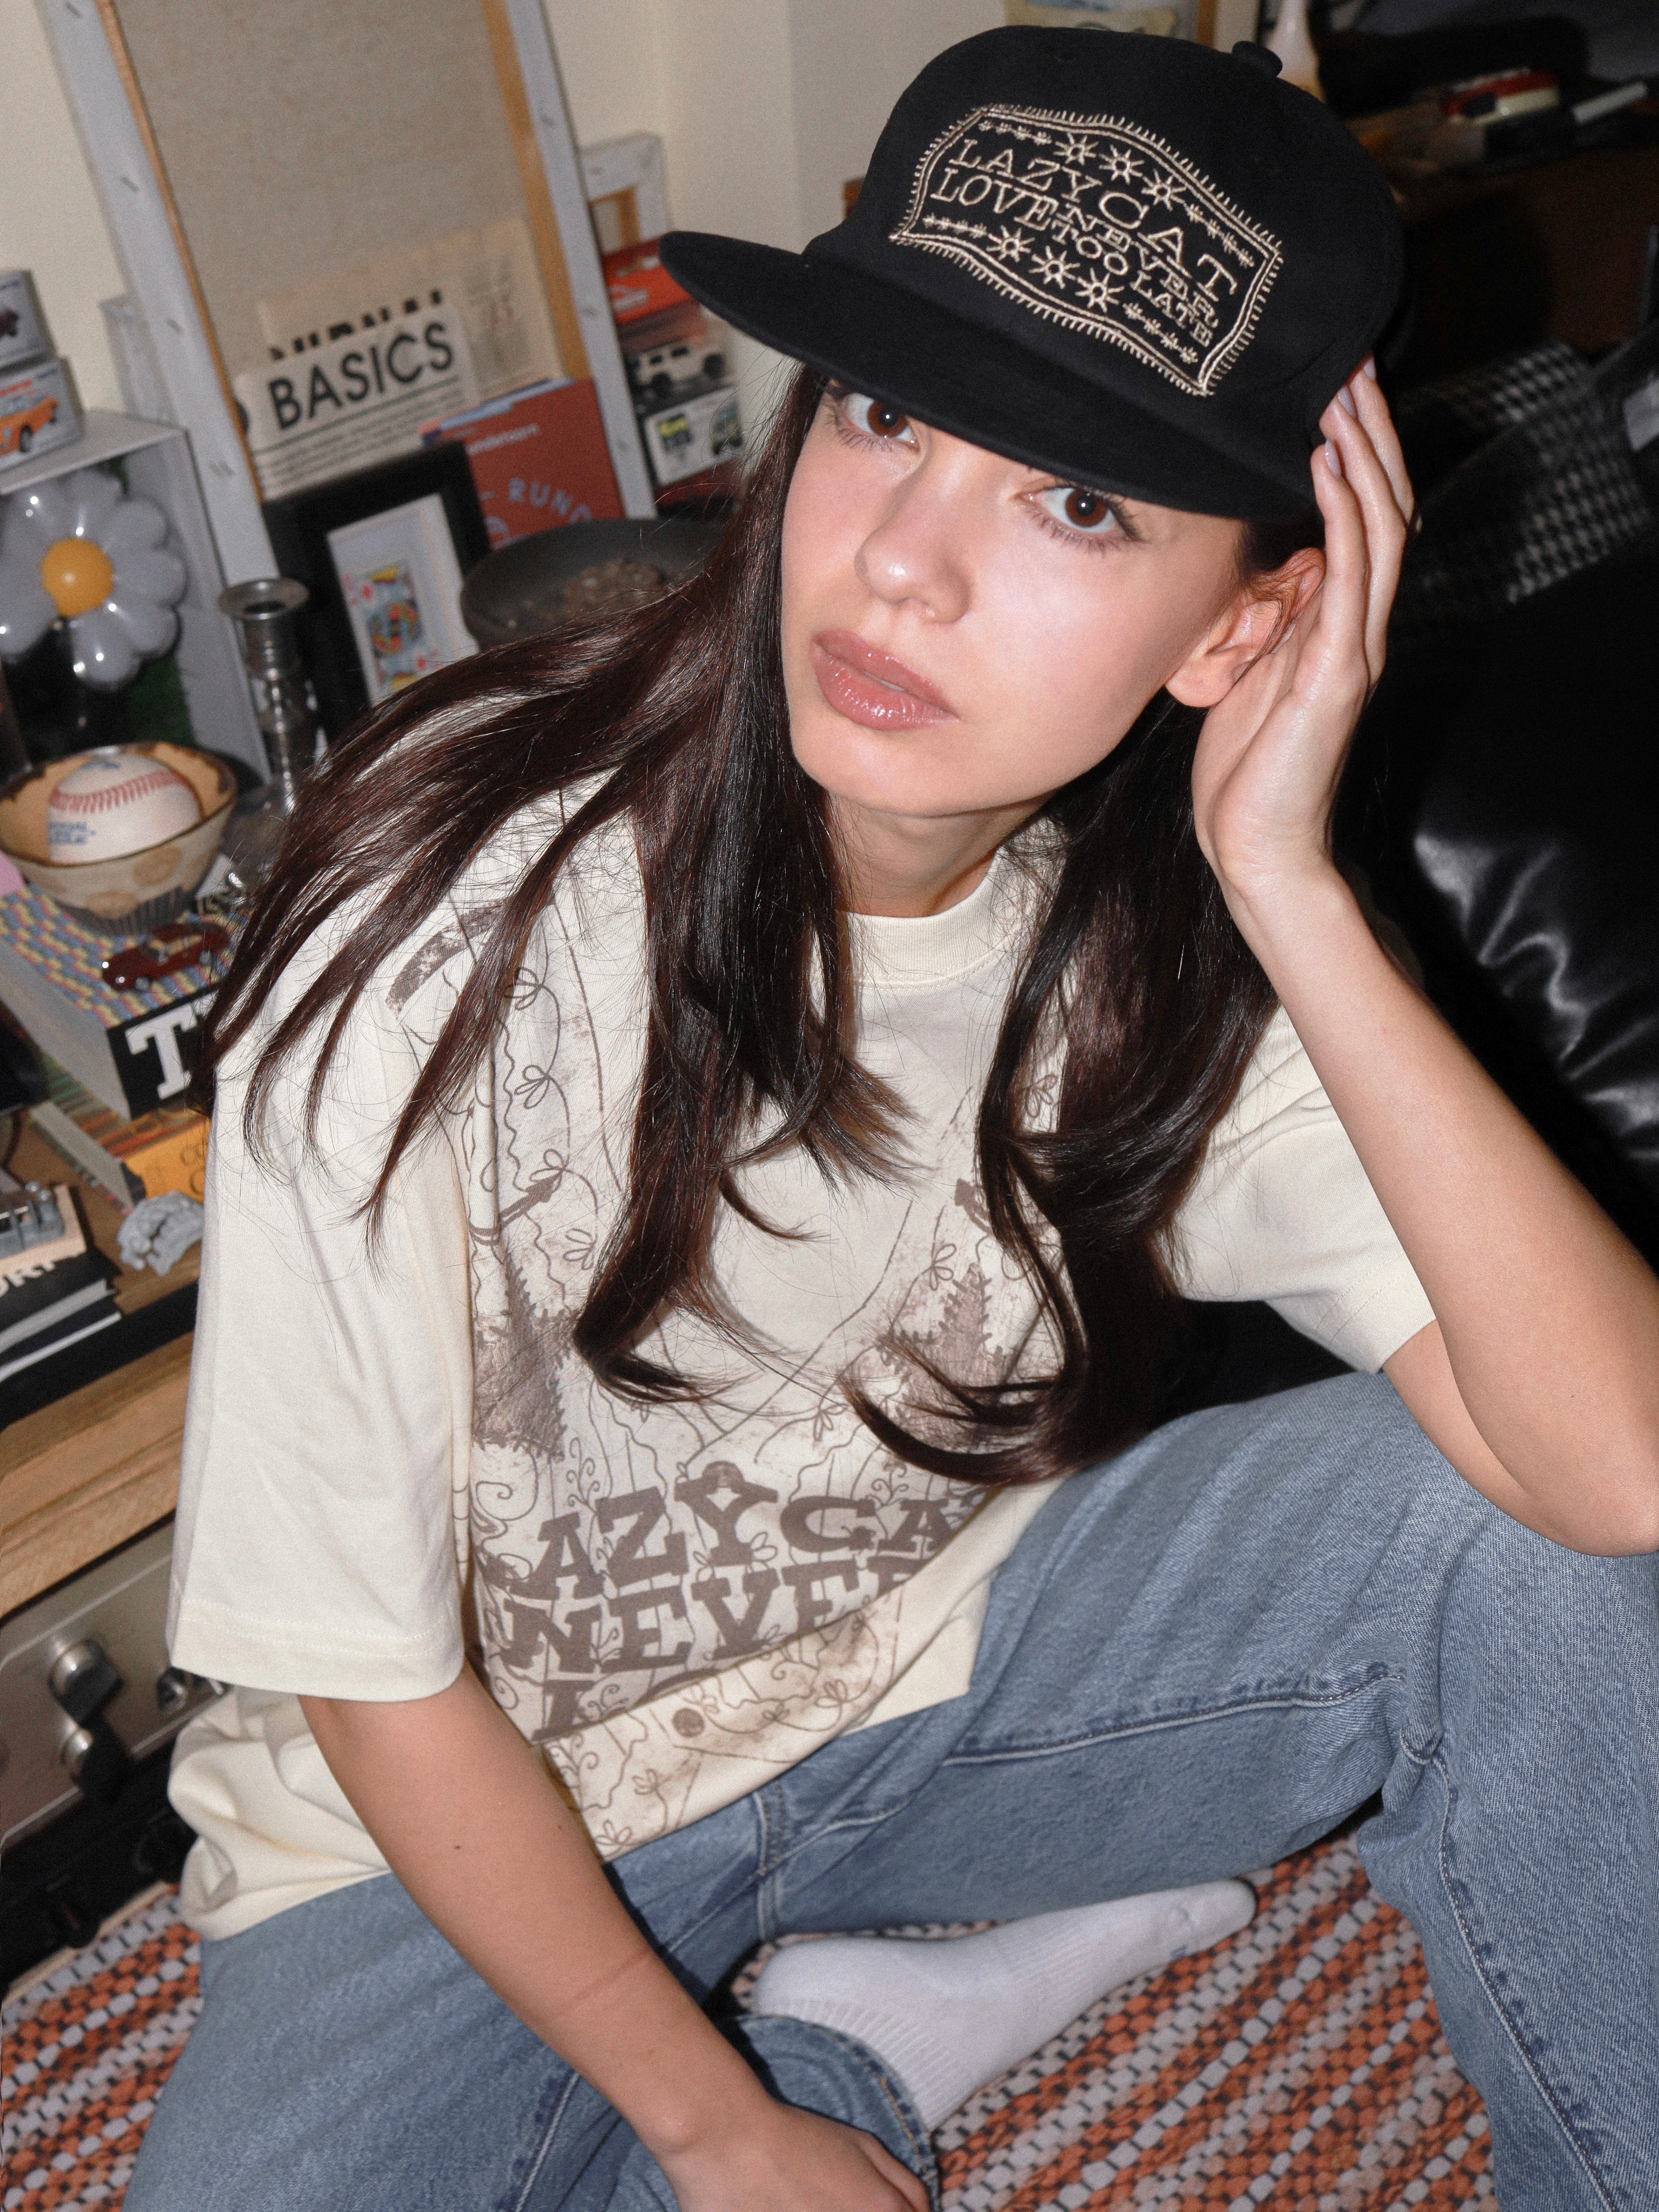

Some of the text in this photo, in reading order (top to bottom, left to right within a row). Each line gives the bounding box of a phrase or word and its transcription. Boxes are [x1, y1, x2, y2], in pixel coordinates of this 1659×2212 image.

[930, 168, 1219, 328] LOVE NEVER
[1051, 219, 1213, 347] TOO LATE
[268, 322, 453, 430] BASICS
[124, 991, 217, 1100] T
